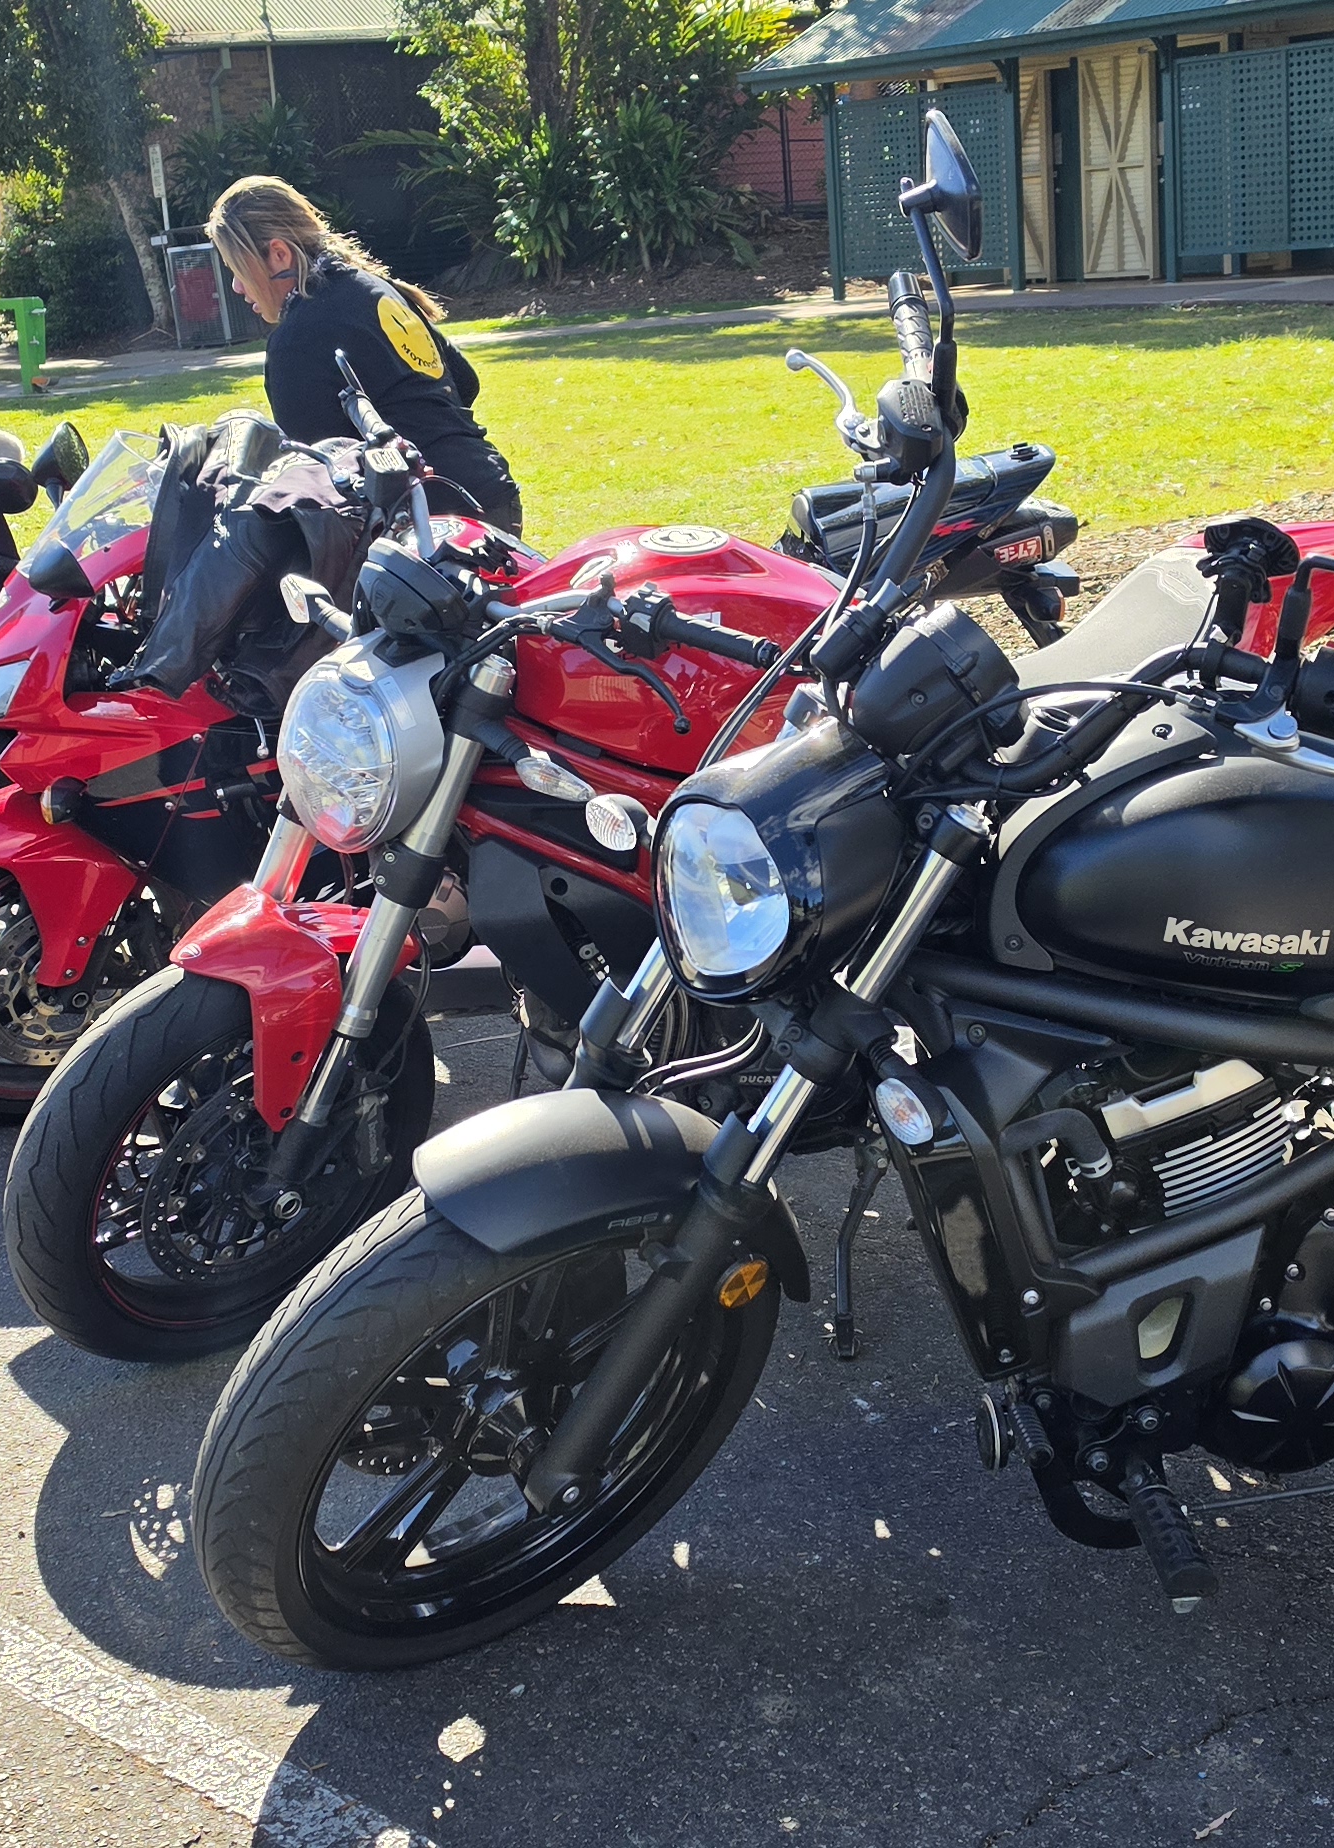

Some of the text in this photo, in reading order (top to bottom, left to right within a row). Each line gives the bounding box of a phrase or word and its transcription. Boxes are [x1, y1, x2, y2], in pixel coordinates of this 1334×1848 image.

[999, 540, 1037, 563] ヨシムラ
[1163, 917, 1331, 955] Kawasaki
[1271, 961, 1304, 972] S
[739, 1075, 779, 1083] DUCAT
[607, 1212, 659, 1230] ABS
